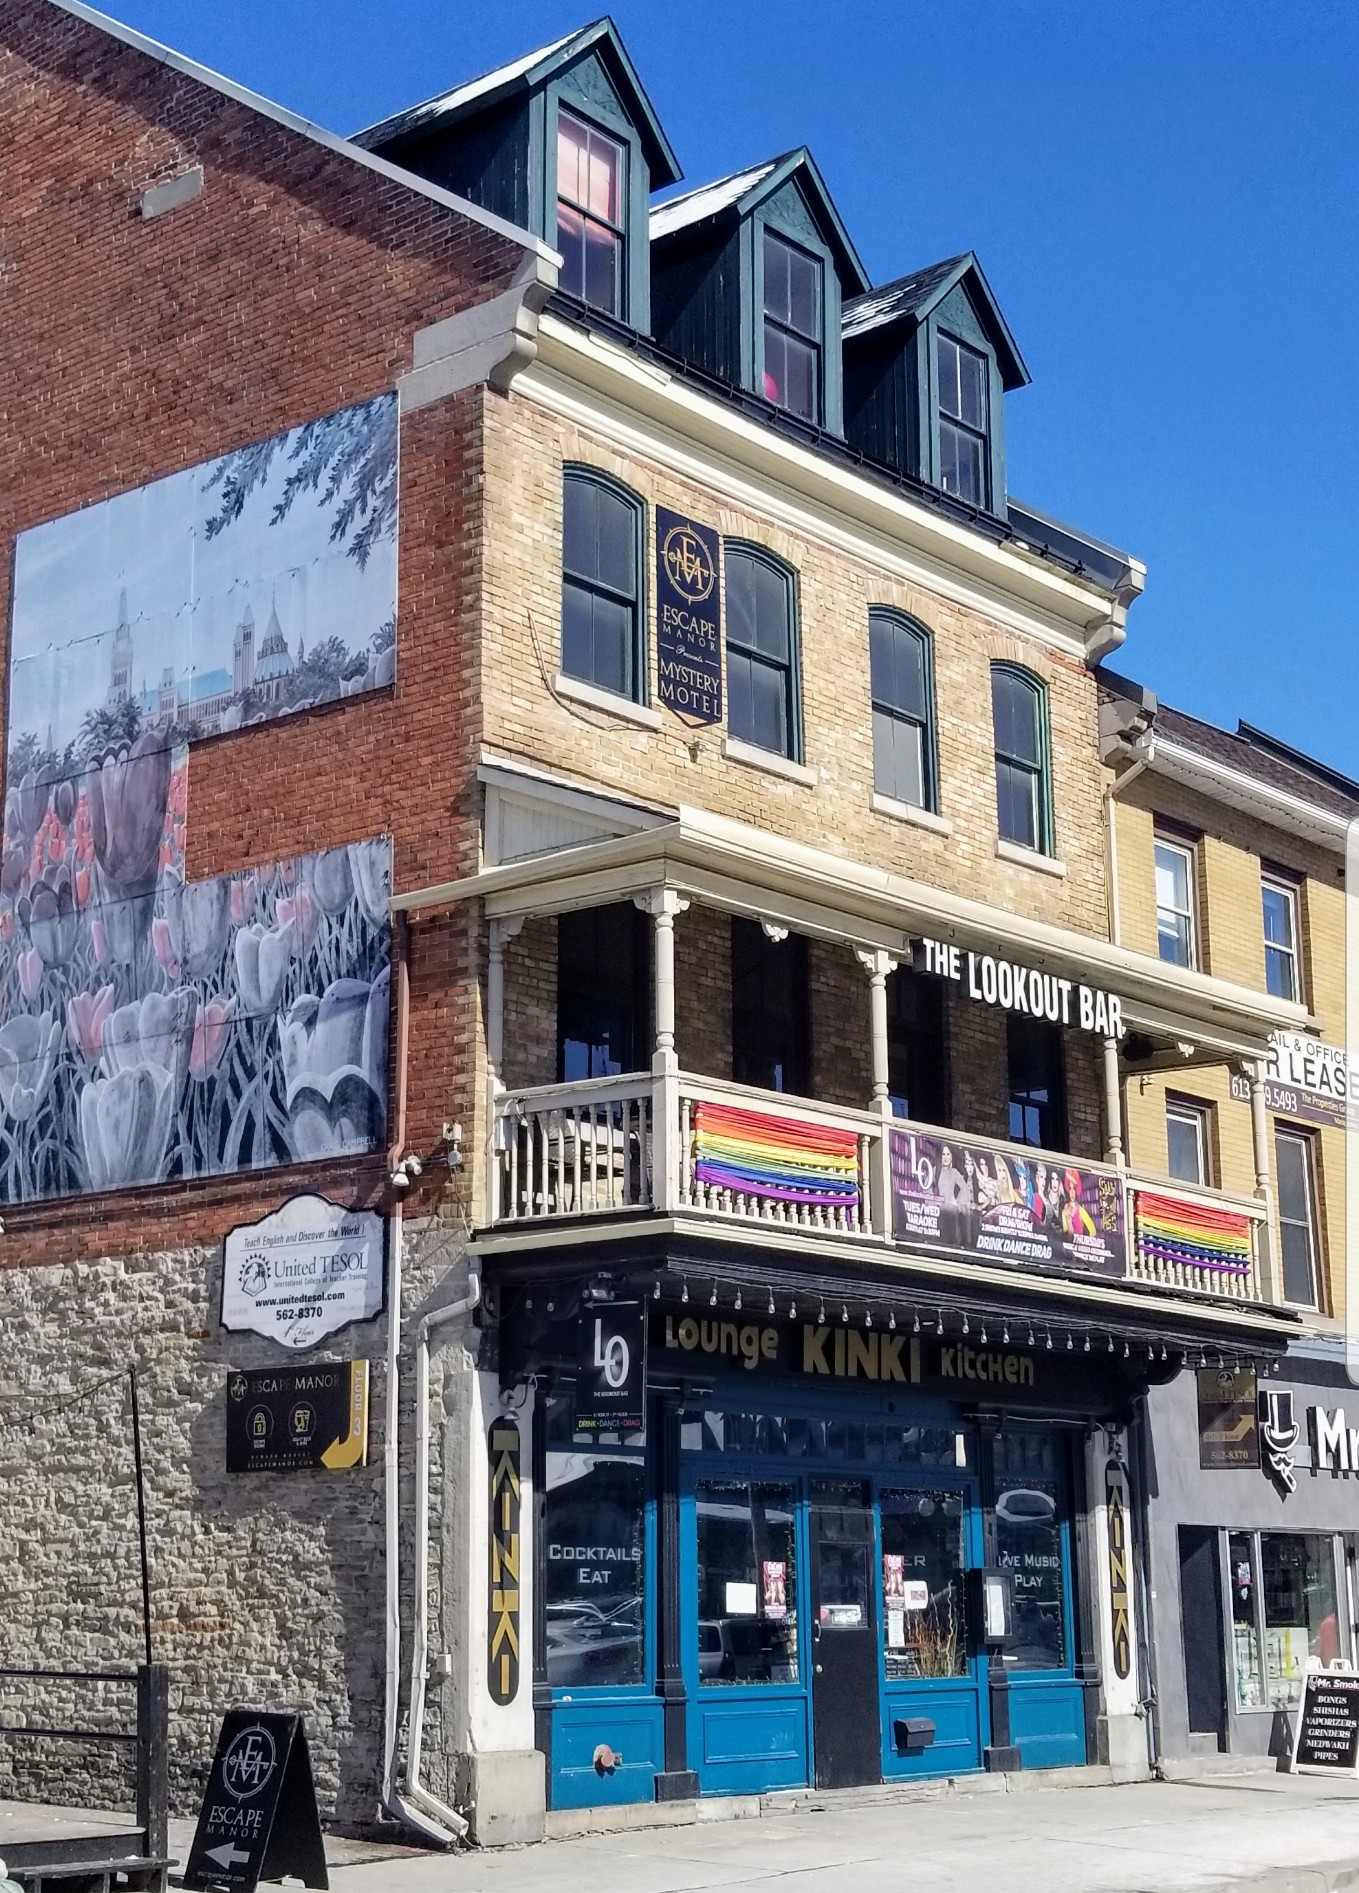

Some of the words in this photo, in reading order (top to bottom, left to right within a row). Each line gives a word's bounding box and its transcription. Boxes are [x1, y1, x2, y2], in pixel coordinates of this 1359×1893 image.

[662, 604, 716, 640] ESCAPE
[662, 625, 716, 652] MANOR
[676, 645, 704, 664] Presents
[660, 658, 719, 694] MYSTERY
[660, 680, 720, 717] MOTEL
[922, 938, 960, 980] THE
[968, 952, 1072, 1024] LOOKOUT
[1079, 985, 1124, 1040] BAR
[1294, 1038, 1302, 1052] &
[1306, 1042, 1350, 1066] OFFICE
[342, 1136, 377, 1148] CAMPBELL
[902, 1200, 940, 1218] TUES/WED
[906, 1212, 938, 1228] KARAOKE
[244, 1237, 260, 1248] Teach
[262, 1235, 284, 1248] English
[286, 1232, 297, 1243] and
[299, 1230, 325, 1241] Discover
[328, 1228, 338, 1238] the
[341, 1225, 359, 1236] World
[976, 1235, 1004, 1251] DRINK
[1003, 1240, 1031, 1255] DANCE
[1031, 1243, 1052, 1259] DRAG
[274, 1256, 316, 1278] United
[320, 1252, 368, 1272] TESOL
[274, 1278, 302, 1288] International
[255, 1291, 345, 1307] www.unitedtesol.com
[276, 1307, 322, 1320] 562-8370
[803, 1325, 920, 1384] KINKI
[295, 1375, 339, 1390] MANOR
[492, 1430, 519, 1694] KINKI
[1107, 1470, 1130, 1672] KINKI
[1318, 1679, 1331, 1688] Mr.
[1318, 1696, 1347, 1704] BONGS
[1313, 1707, 1349, 1715] SHISHAS
[1306, 1717, 1357, 1727] VAPORIZERS
[1308, 1729, 1350, 1738] GRINDERS
[1306, 1740, 1350, 1750] MEDWAKH
[1314, 1751, 1338, 1760] PIPES
[209, 1806, 264, 1827] ESCAPE
[206, 1824, 258, 1838] MANOR
